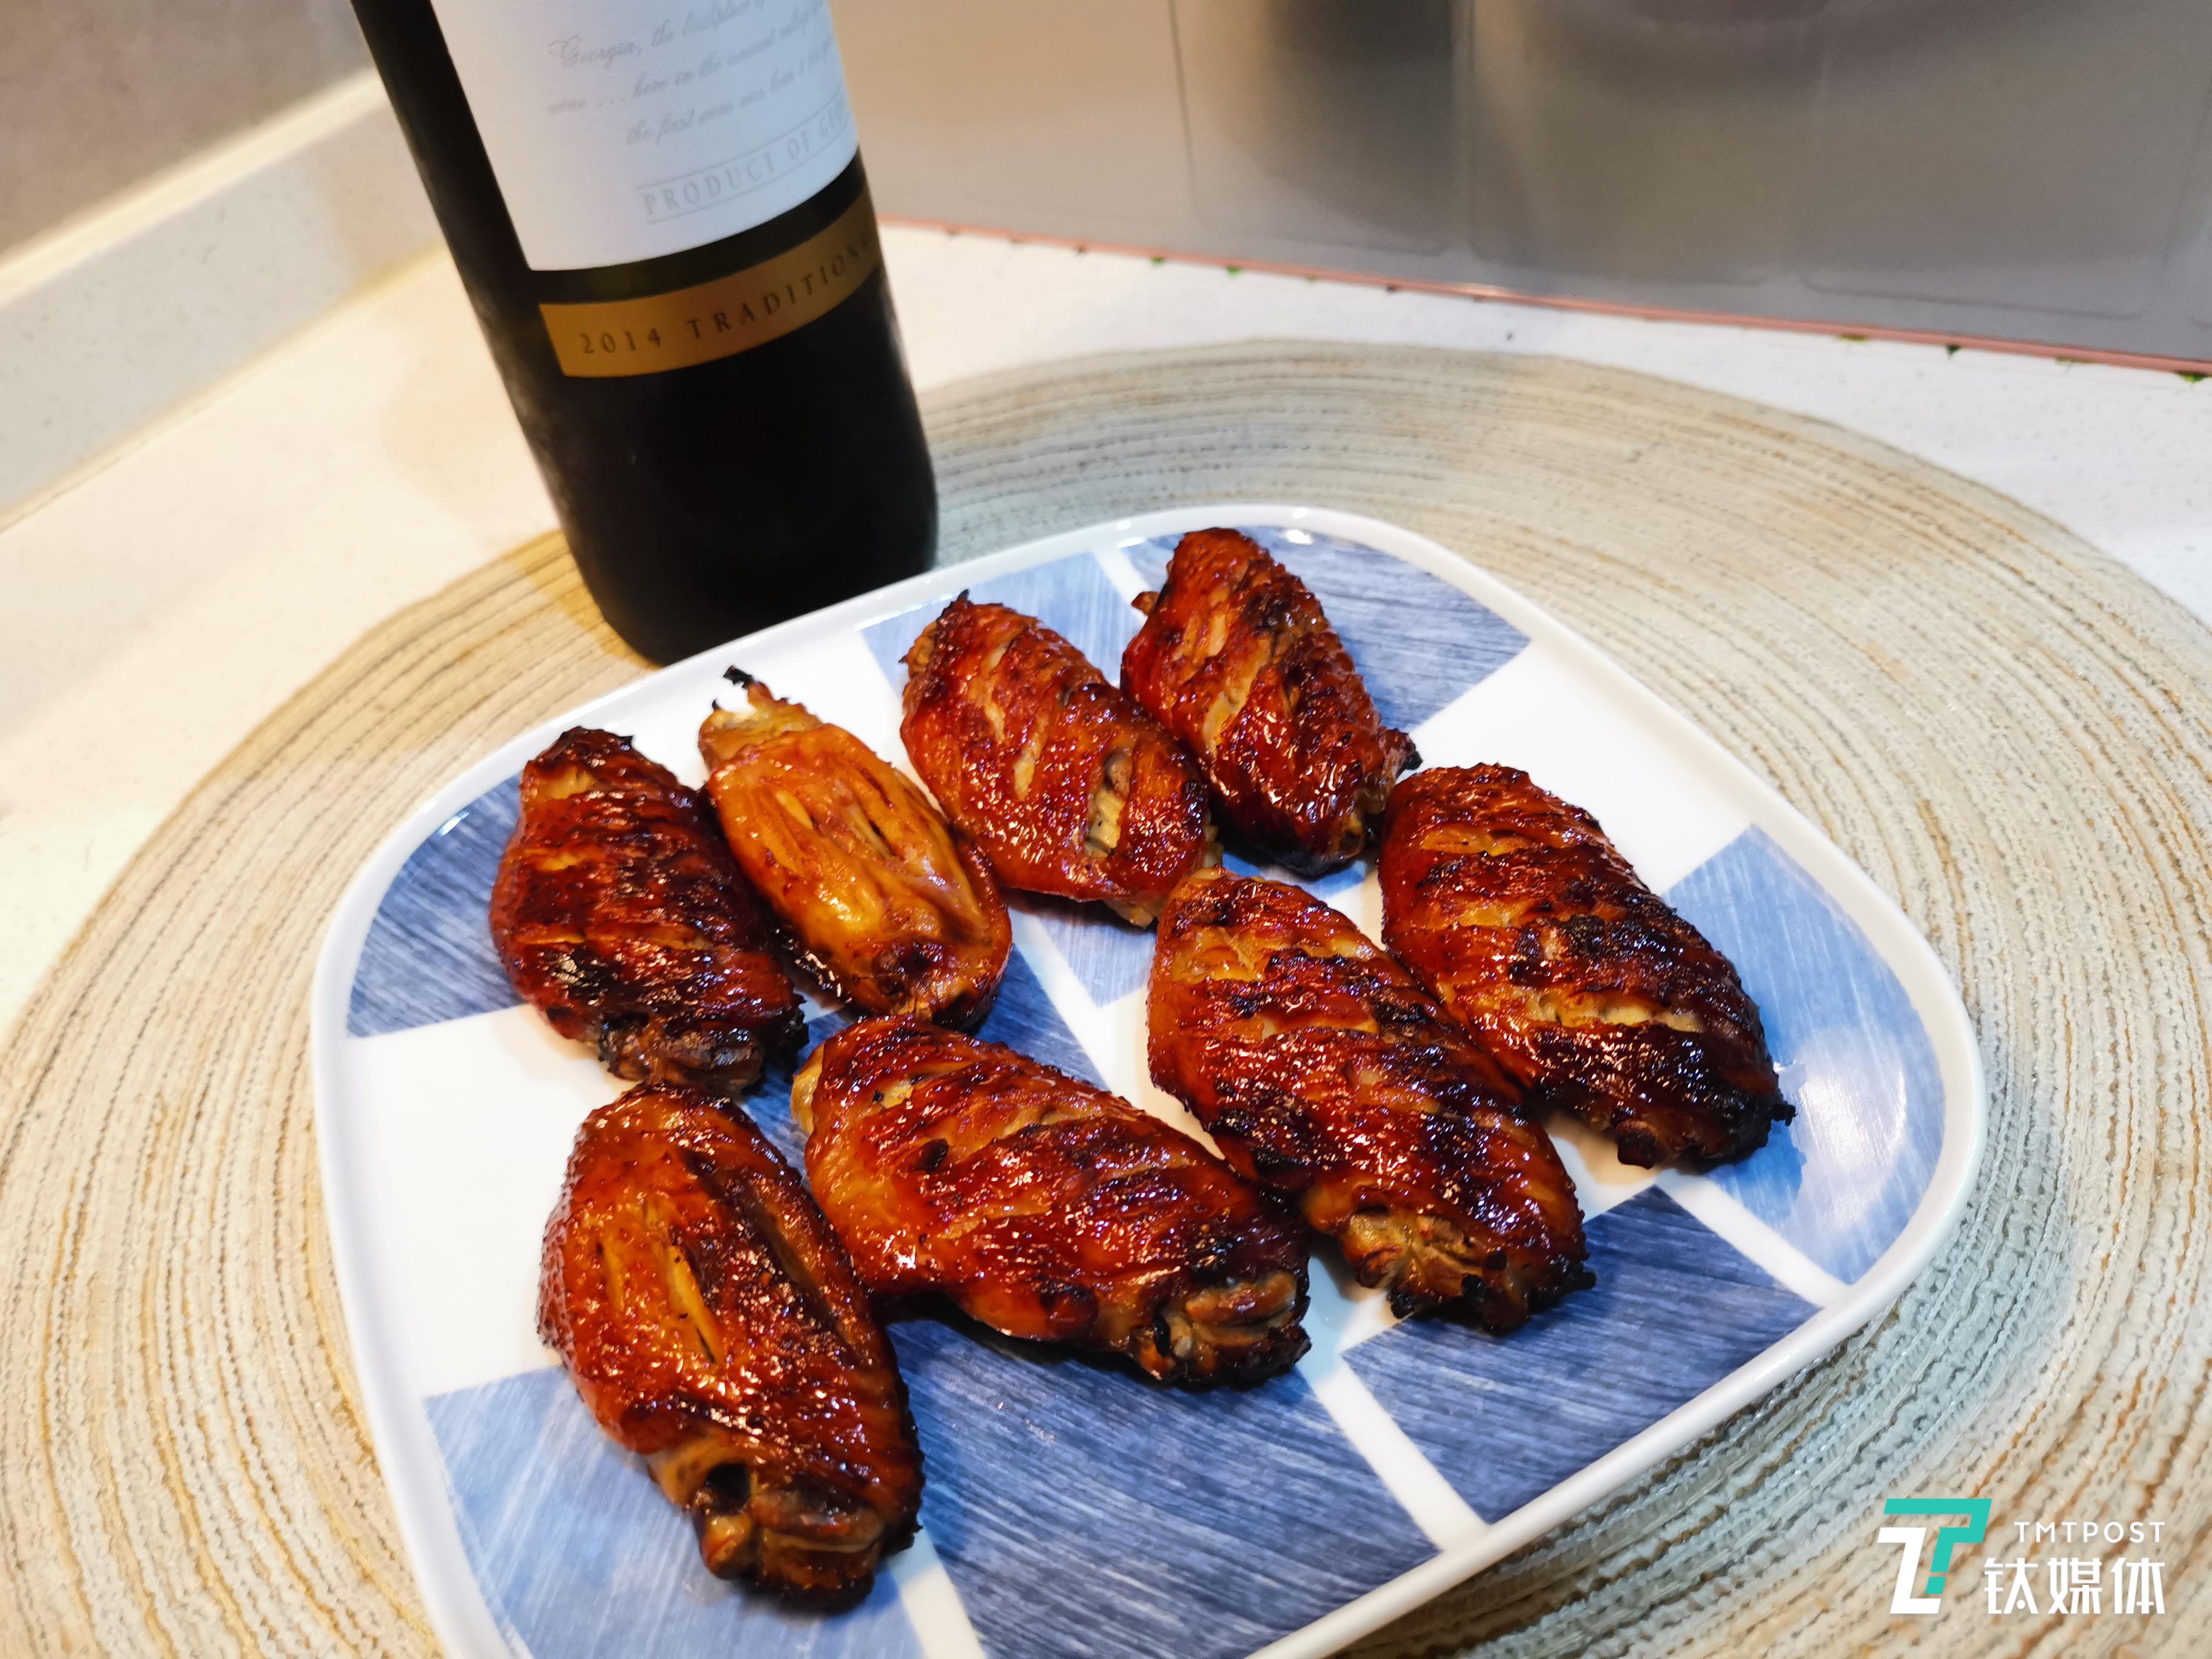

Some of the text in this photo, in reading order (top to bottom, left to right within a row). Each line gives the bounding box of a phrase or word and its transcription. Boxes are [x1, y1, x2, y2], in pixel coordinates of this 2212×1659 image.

[548, 35, 643, 70] Georgia,
[651, 19, 677, 47] the
[699, 50, 723, 77] the
[626, 119, 652, 146] the
[643, 152, 776, 216] PRODUCT
[788, 129, 811, 161] OF
[580, 327, 662, 354] 2014
